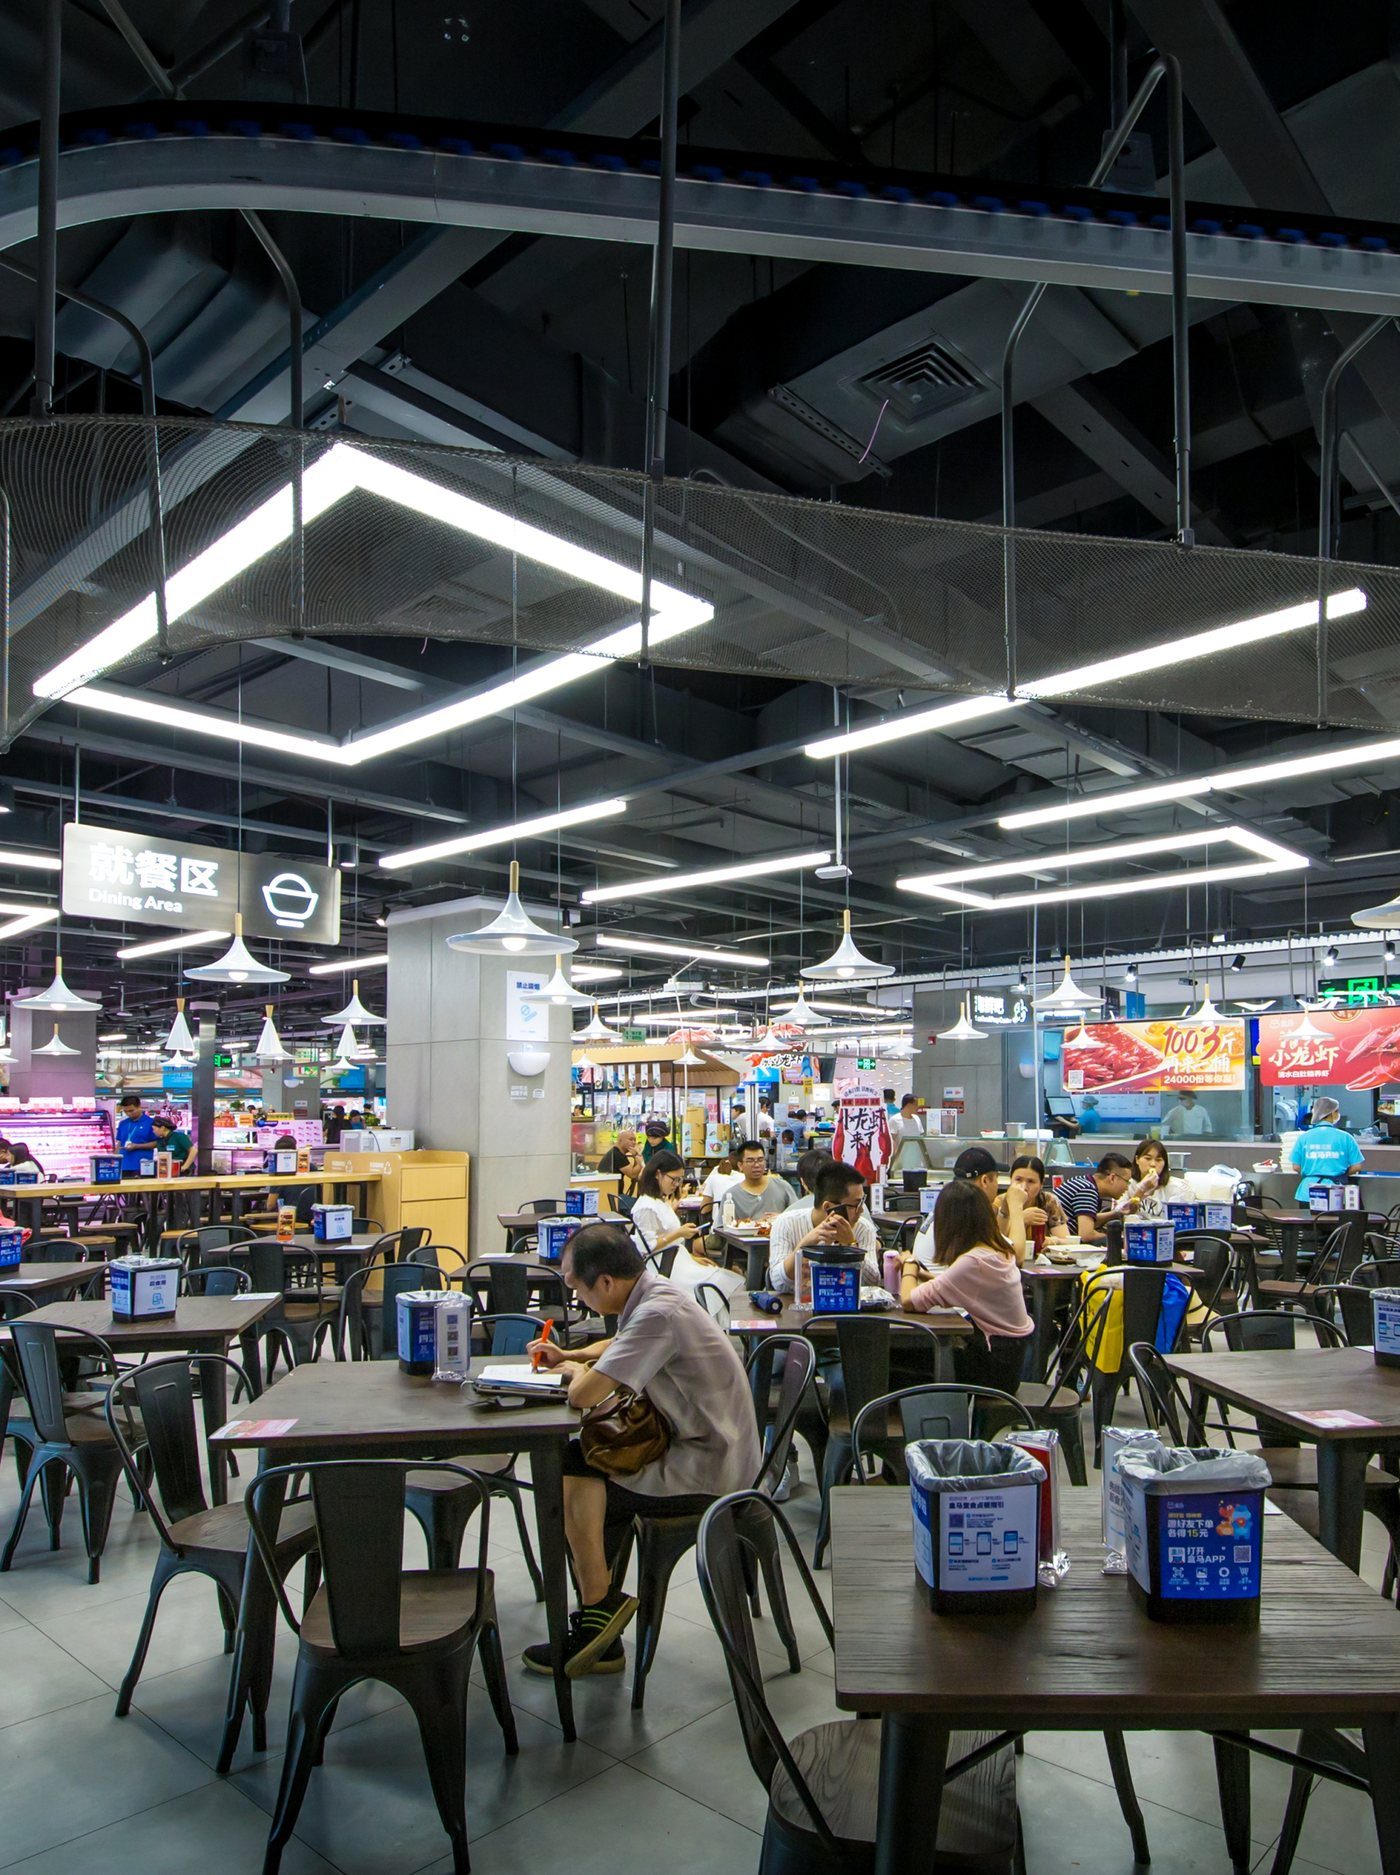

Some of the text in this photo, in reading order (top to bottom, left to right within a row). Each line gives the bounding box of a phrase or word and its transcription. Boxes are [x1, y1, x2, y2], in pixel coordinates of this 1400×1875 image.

[89, 843, 219, 897] 就餐区
[88, 888, 183, 914] Dining Area
[1268, 1045, 1340, 1072] 小龙虾
[850, 1131, 875, 1152] 来了
[1167, 1519, 1214, 1529] 邀好友下单
[1168, 1528, 1209, 1538] 各得15元
[1187, 1546, 1205, 1555] 打开
[1187, 1555, 1226, 1564] 盒马APP
